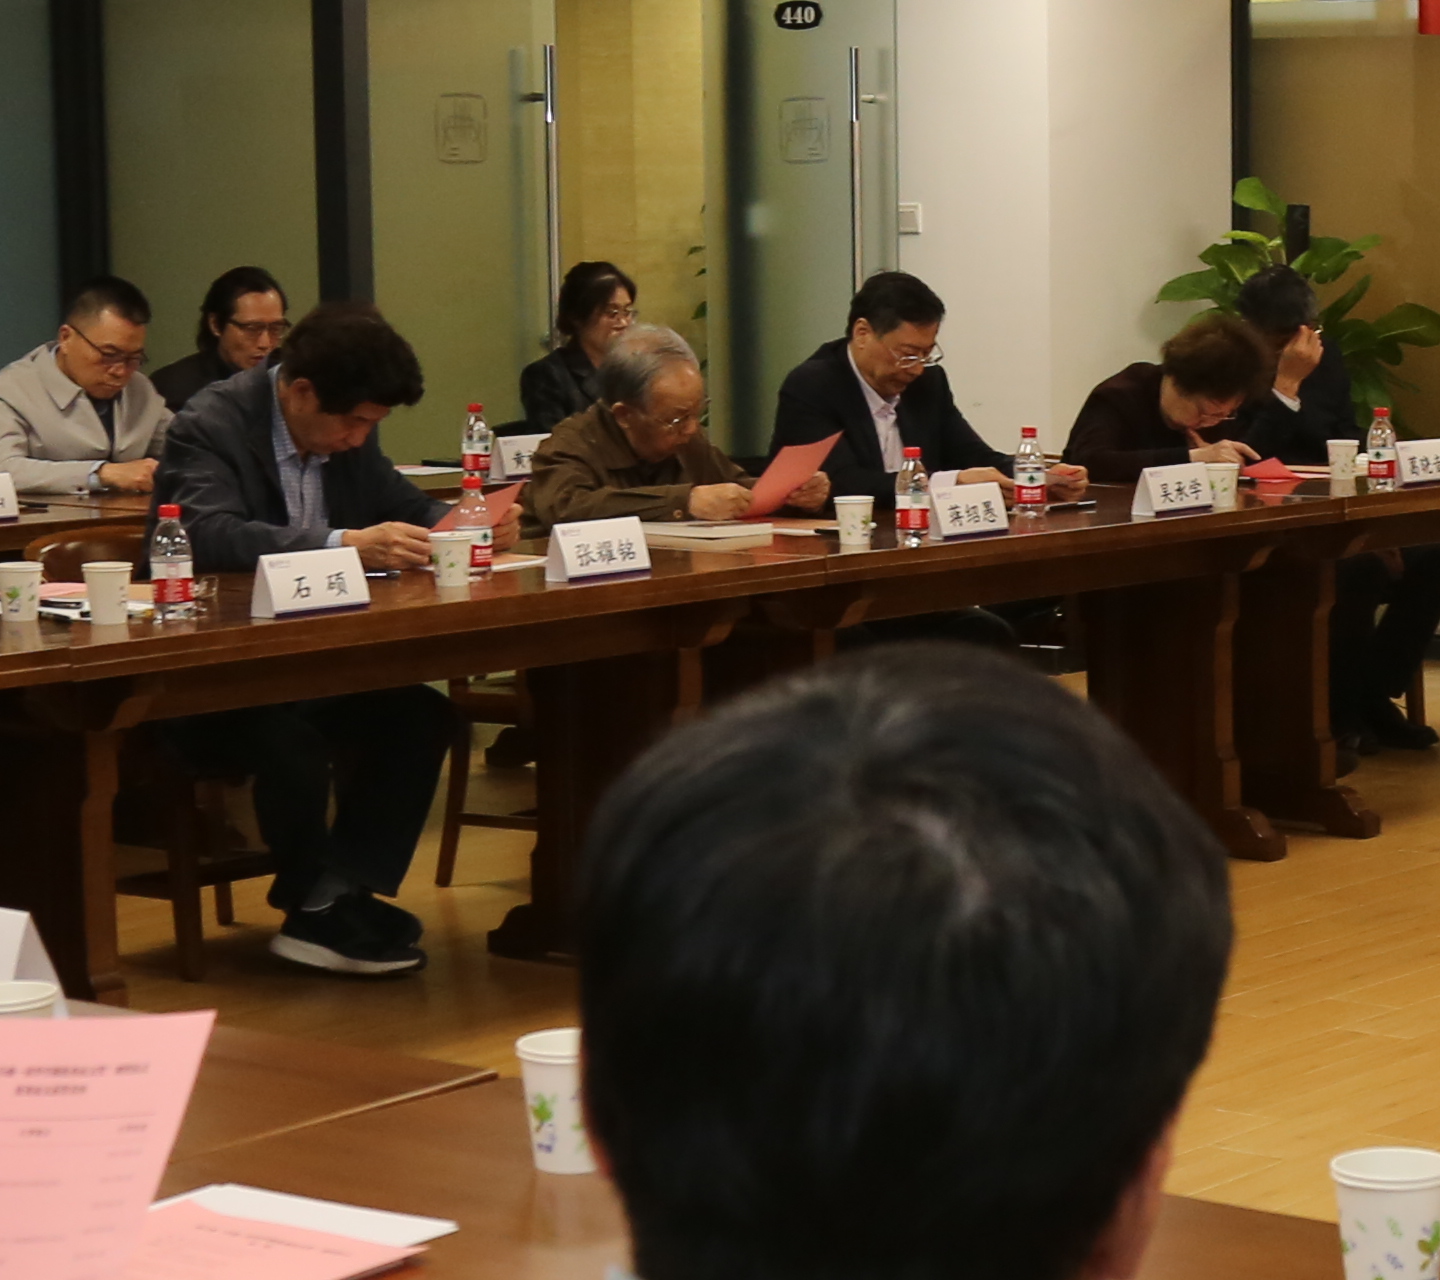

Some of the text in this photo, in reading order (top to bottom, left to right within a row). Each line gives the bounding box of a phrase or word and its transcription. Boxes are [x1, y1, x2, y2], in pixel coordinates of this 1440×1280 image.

[781, 6, 816, 24] 440
[1159, 477, 1203, 504] 吴承学
